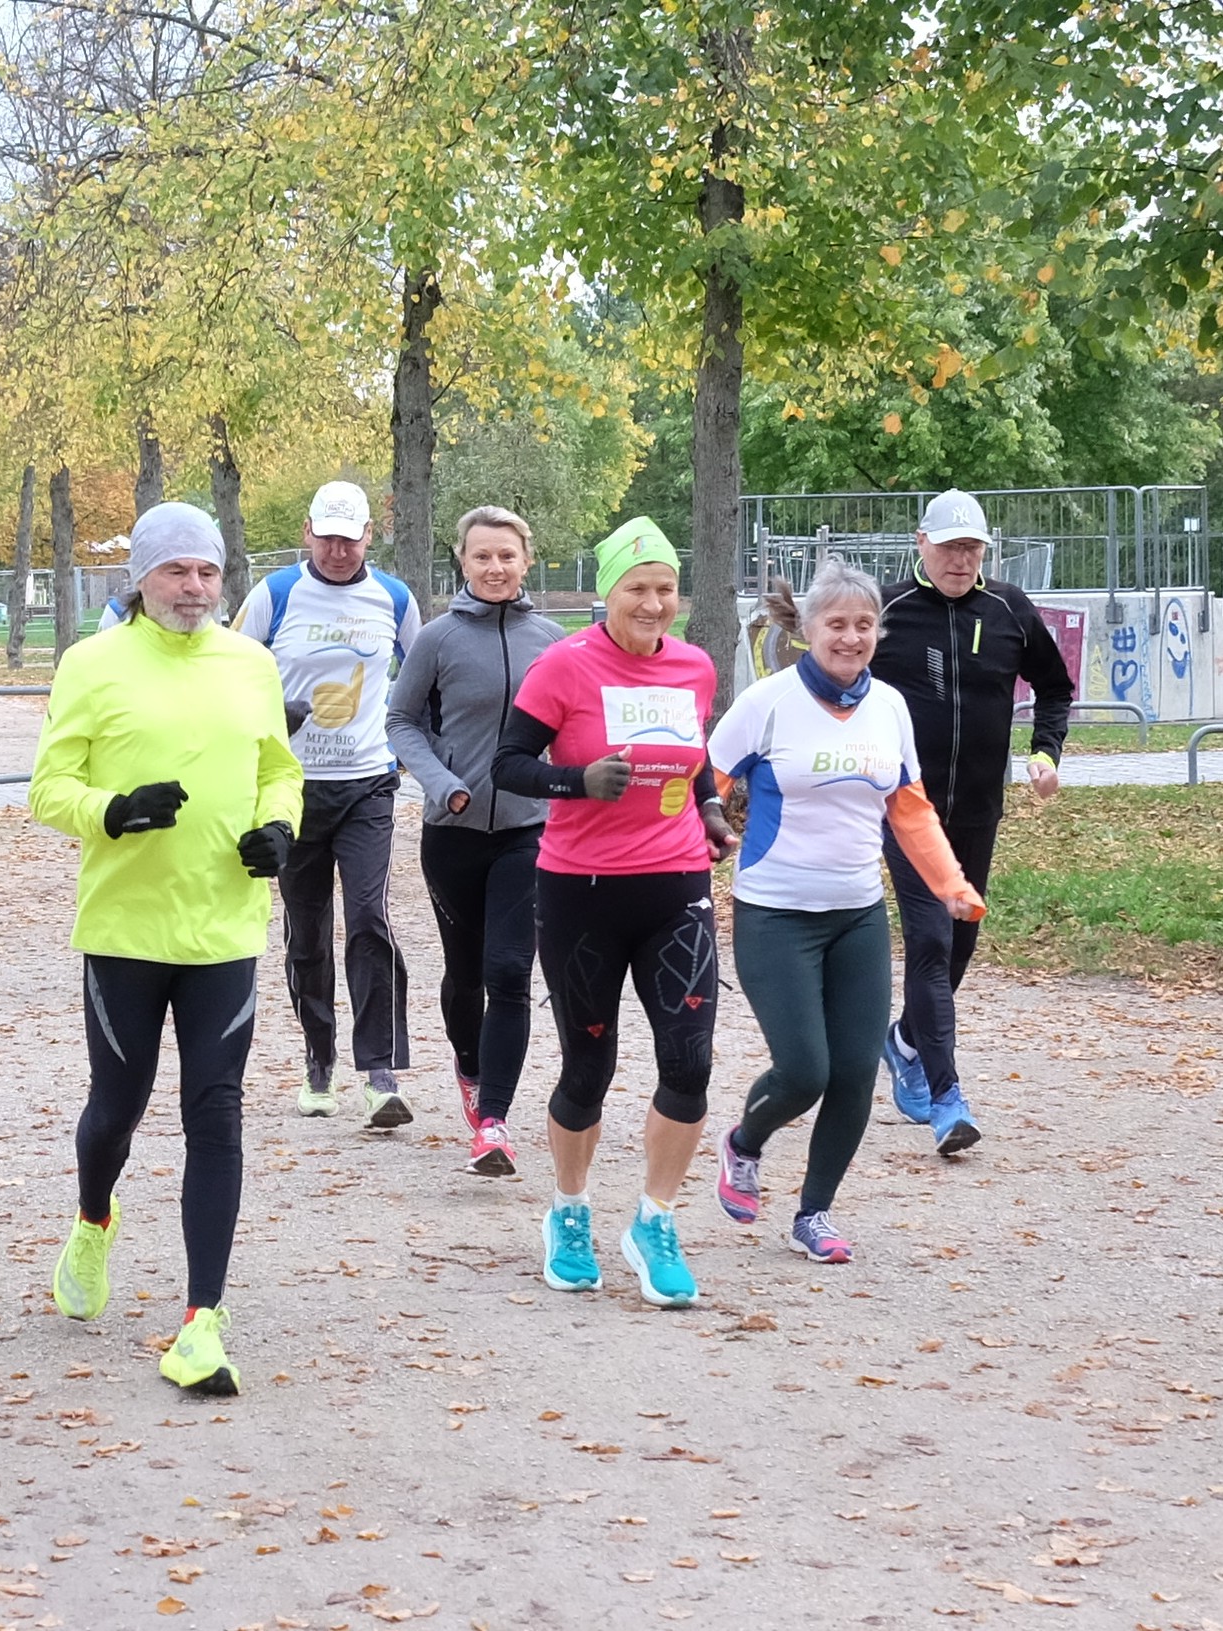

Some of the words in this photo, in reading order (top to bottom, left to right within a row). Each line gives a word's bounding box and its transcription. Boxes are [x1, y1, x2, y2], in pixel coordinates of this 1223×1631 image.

[305, 622, 344, 642] Bio
[622, 702, 659, 724] Bio
[305, 732, 329, 744] MIT
[335, 735, 356, 746] BIO
[304, 745, 355, 757] BANANEN
[811, 750, 857, 773] Bio
